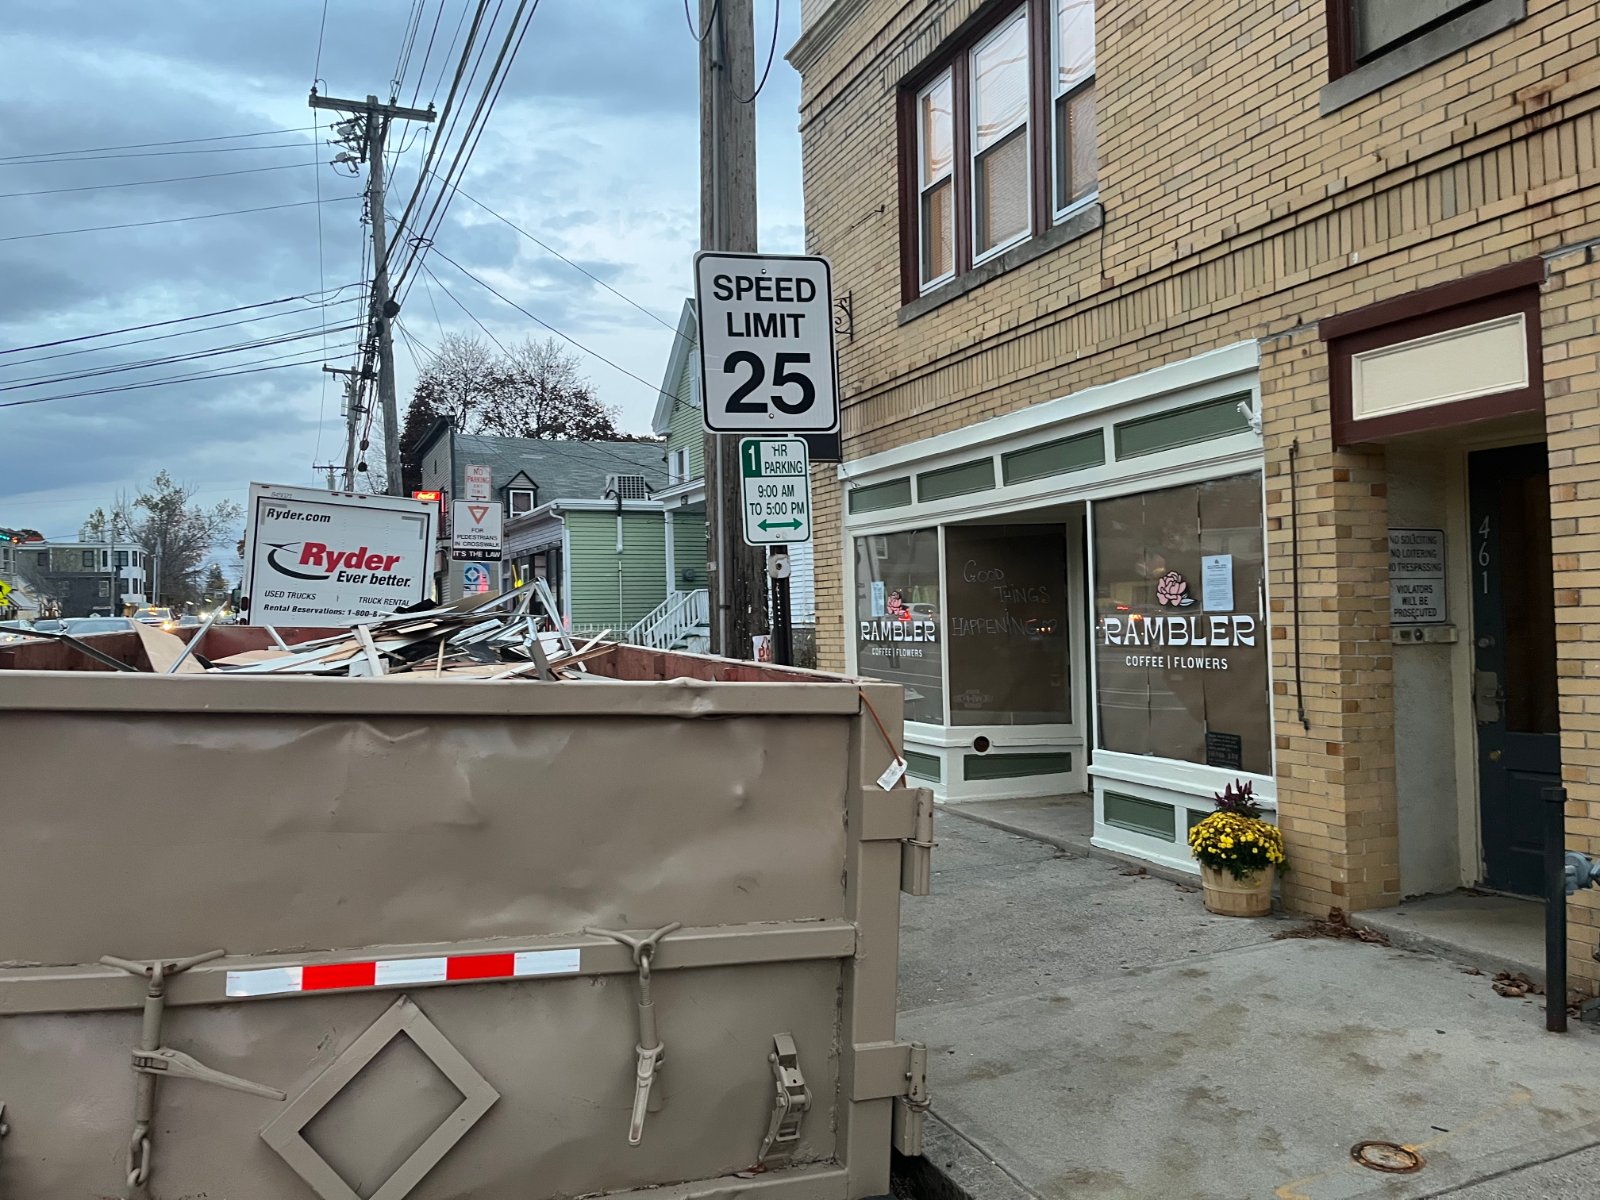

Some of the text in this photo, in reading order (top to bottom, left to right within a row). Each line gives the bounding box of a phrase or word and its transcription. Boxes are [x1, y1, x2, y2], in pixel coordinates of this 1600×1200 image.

[713, 274, 816, 302] SPEED
[727, 312, 805, 338] LIMIT
[723, 350, 815, 414] 25
[773, 444, 788, 456] HR
[748, 445, 756, 470] 1
[764, 461, 803, 474] PARKING
[758, 485, 795, 498] 9:00 AM
[749, 502, 805, 515] TO 5:00 PM
[266, 508, 331, 524] Ryder.com
[299, 542, 400, 573] Ryder
[336, 570, 368, 584] Ever
[264, 590, 317, 600] USED TRUCKS
[1396, 584, 1433, 593] VIOLATORS
[358, 596, 410, 606] TRUCK RENTAL
[1402, 596, 1429, 605] WILL BE
[263, 604, 290, 612] Rental
[291, 605, 345, 616] Reservations:
[1394, 608, 1437, 617] PROSECUTED
[860, 621, 936, 642] RAMBLER
[1103, 615, 1256, 647] RAMBLER
[872, 648, 923, 658] COFFEE FLOWERS
[1125, 655, 1228, 670] COFFEE FLOWERS
